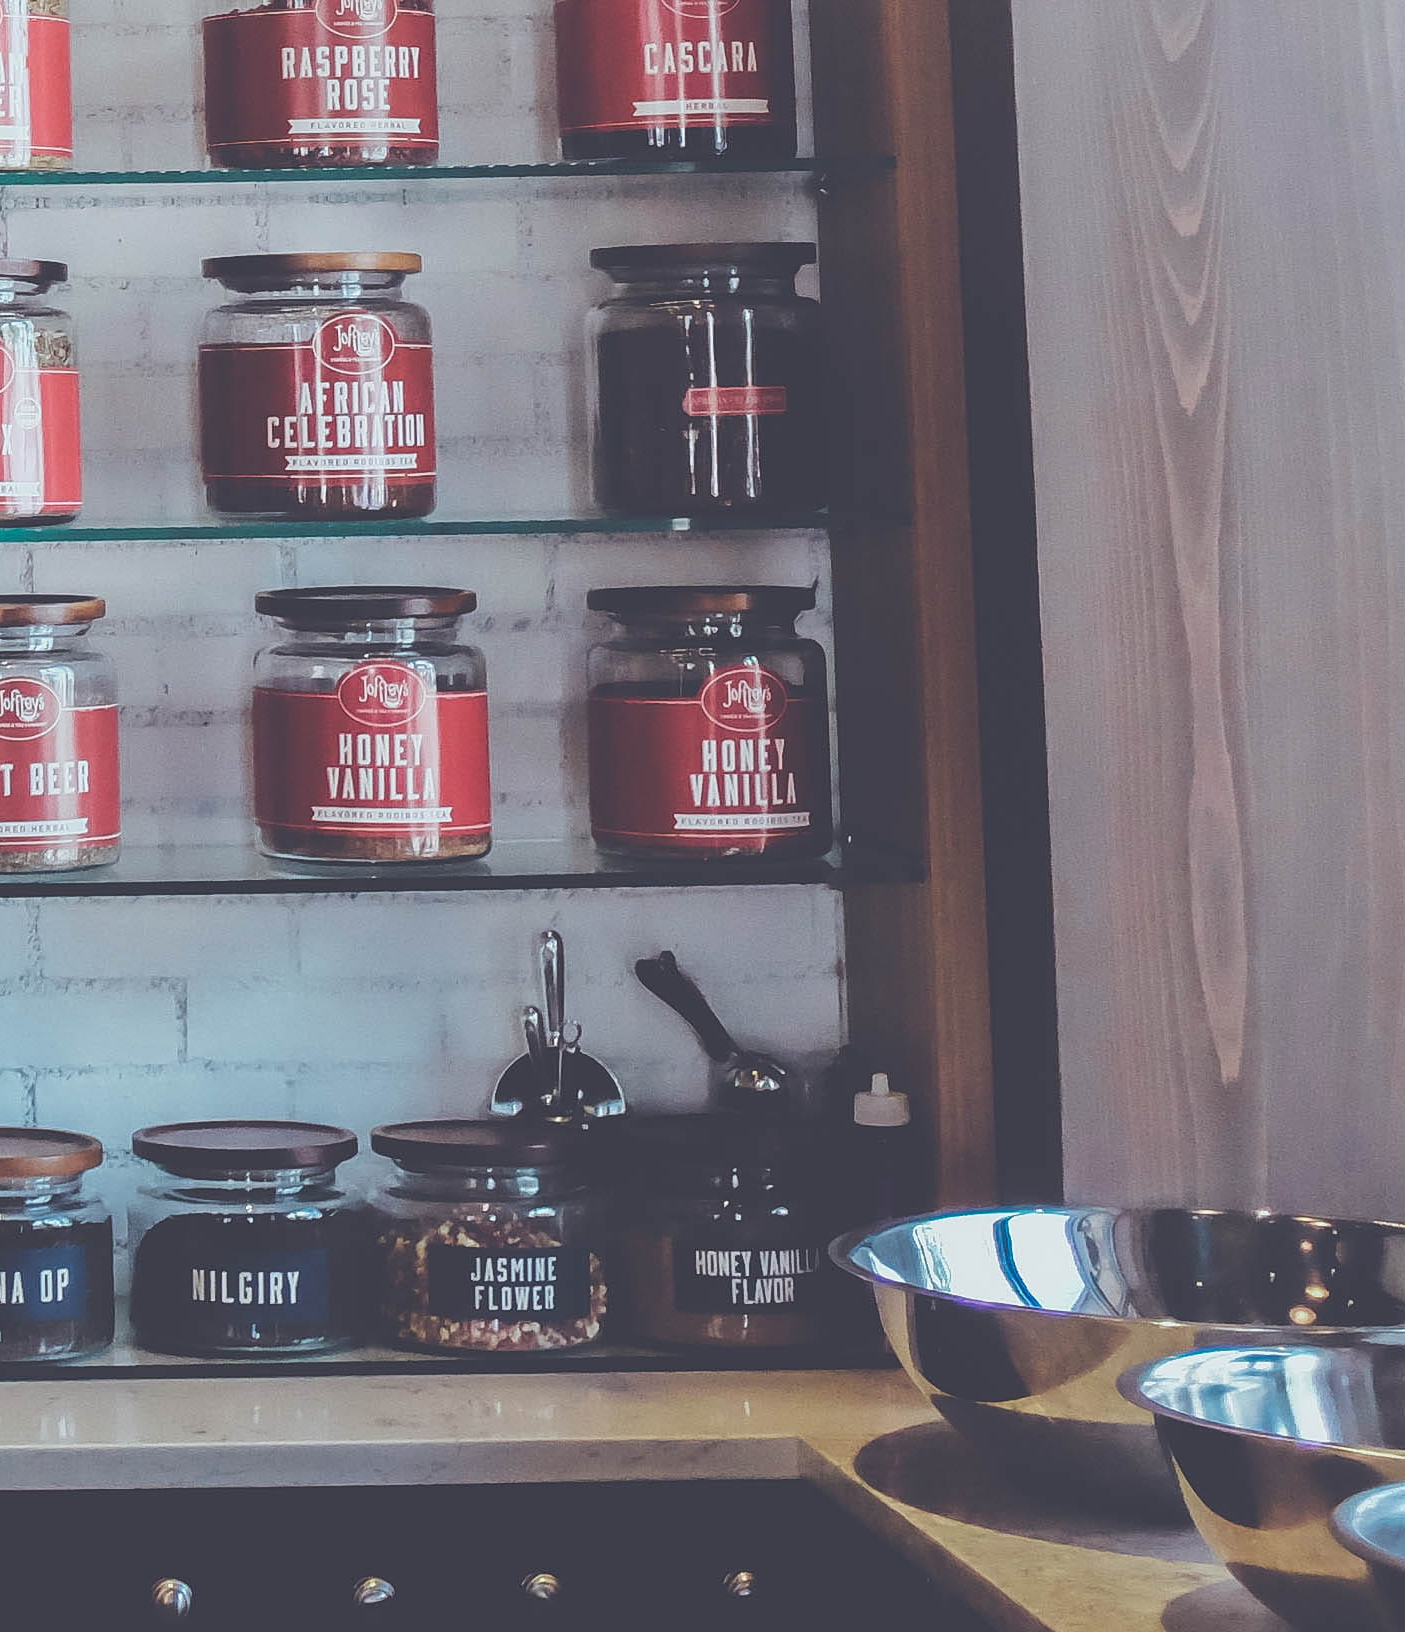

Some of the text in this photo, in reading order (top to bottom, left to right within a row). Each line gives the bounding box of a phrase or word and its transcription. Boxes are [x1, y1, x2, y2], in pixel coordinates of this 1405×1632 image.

[282, 46, 420, 80] RASPBERRY
[644, 40, 758, 75] CASCARA
[326, 78, 390, 111] ROSE
[298, 380, 404, 417] AFRICAN
[267, 413, 425, 450] CELEBRATION
[358, 673, 409, 707] Joffrey's
[339, 733, 423, 767] HONEY
[701, 739, 786, 773] HONEY
[30, 760, 89, 796] BEER
[326, 766, 437, 801] VANILLA
[689, 772, 797, 808] VANILLA
[470, 1255, 557, 1283] JASMINE
[695, 1250, 752, 1277] HONEY
[39, 1268, 70, 1303] OP
[191, 1268, 300, 1305] NILGIRY
[474, 1286, 555, 1311] FLOWER
[731, 1277, 795, 1305] FLAVOR
